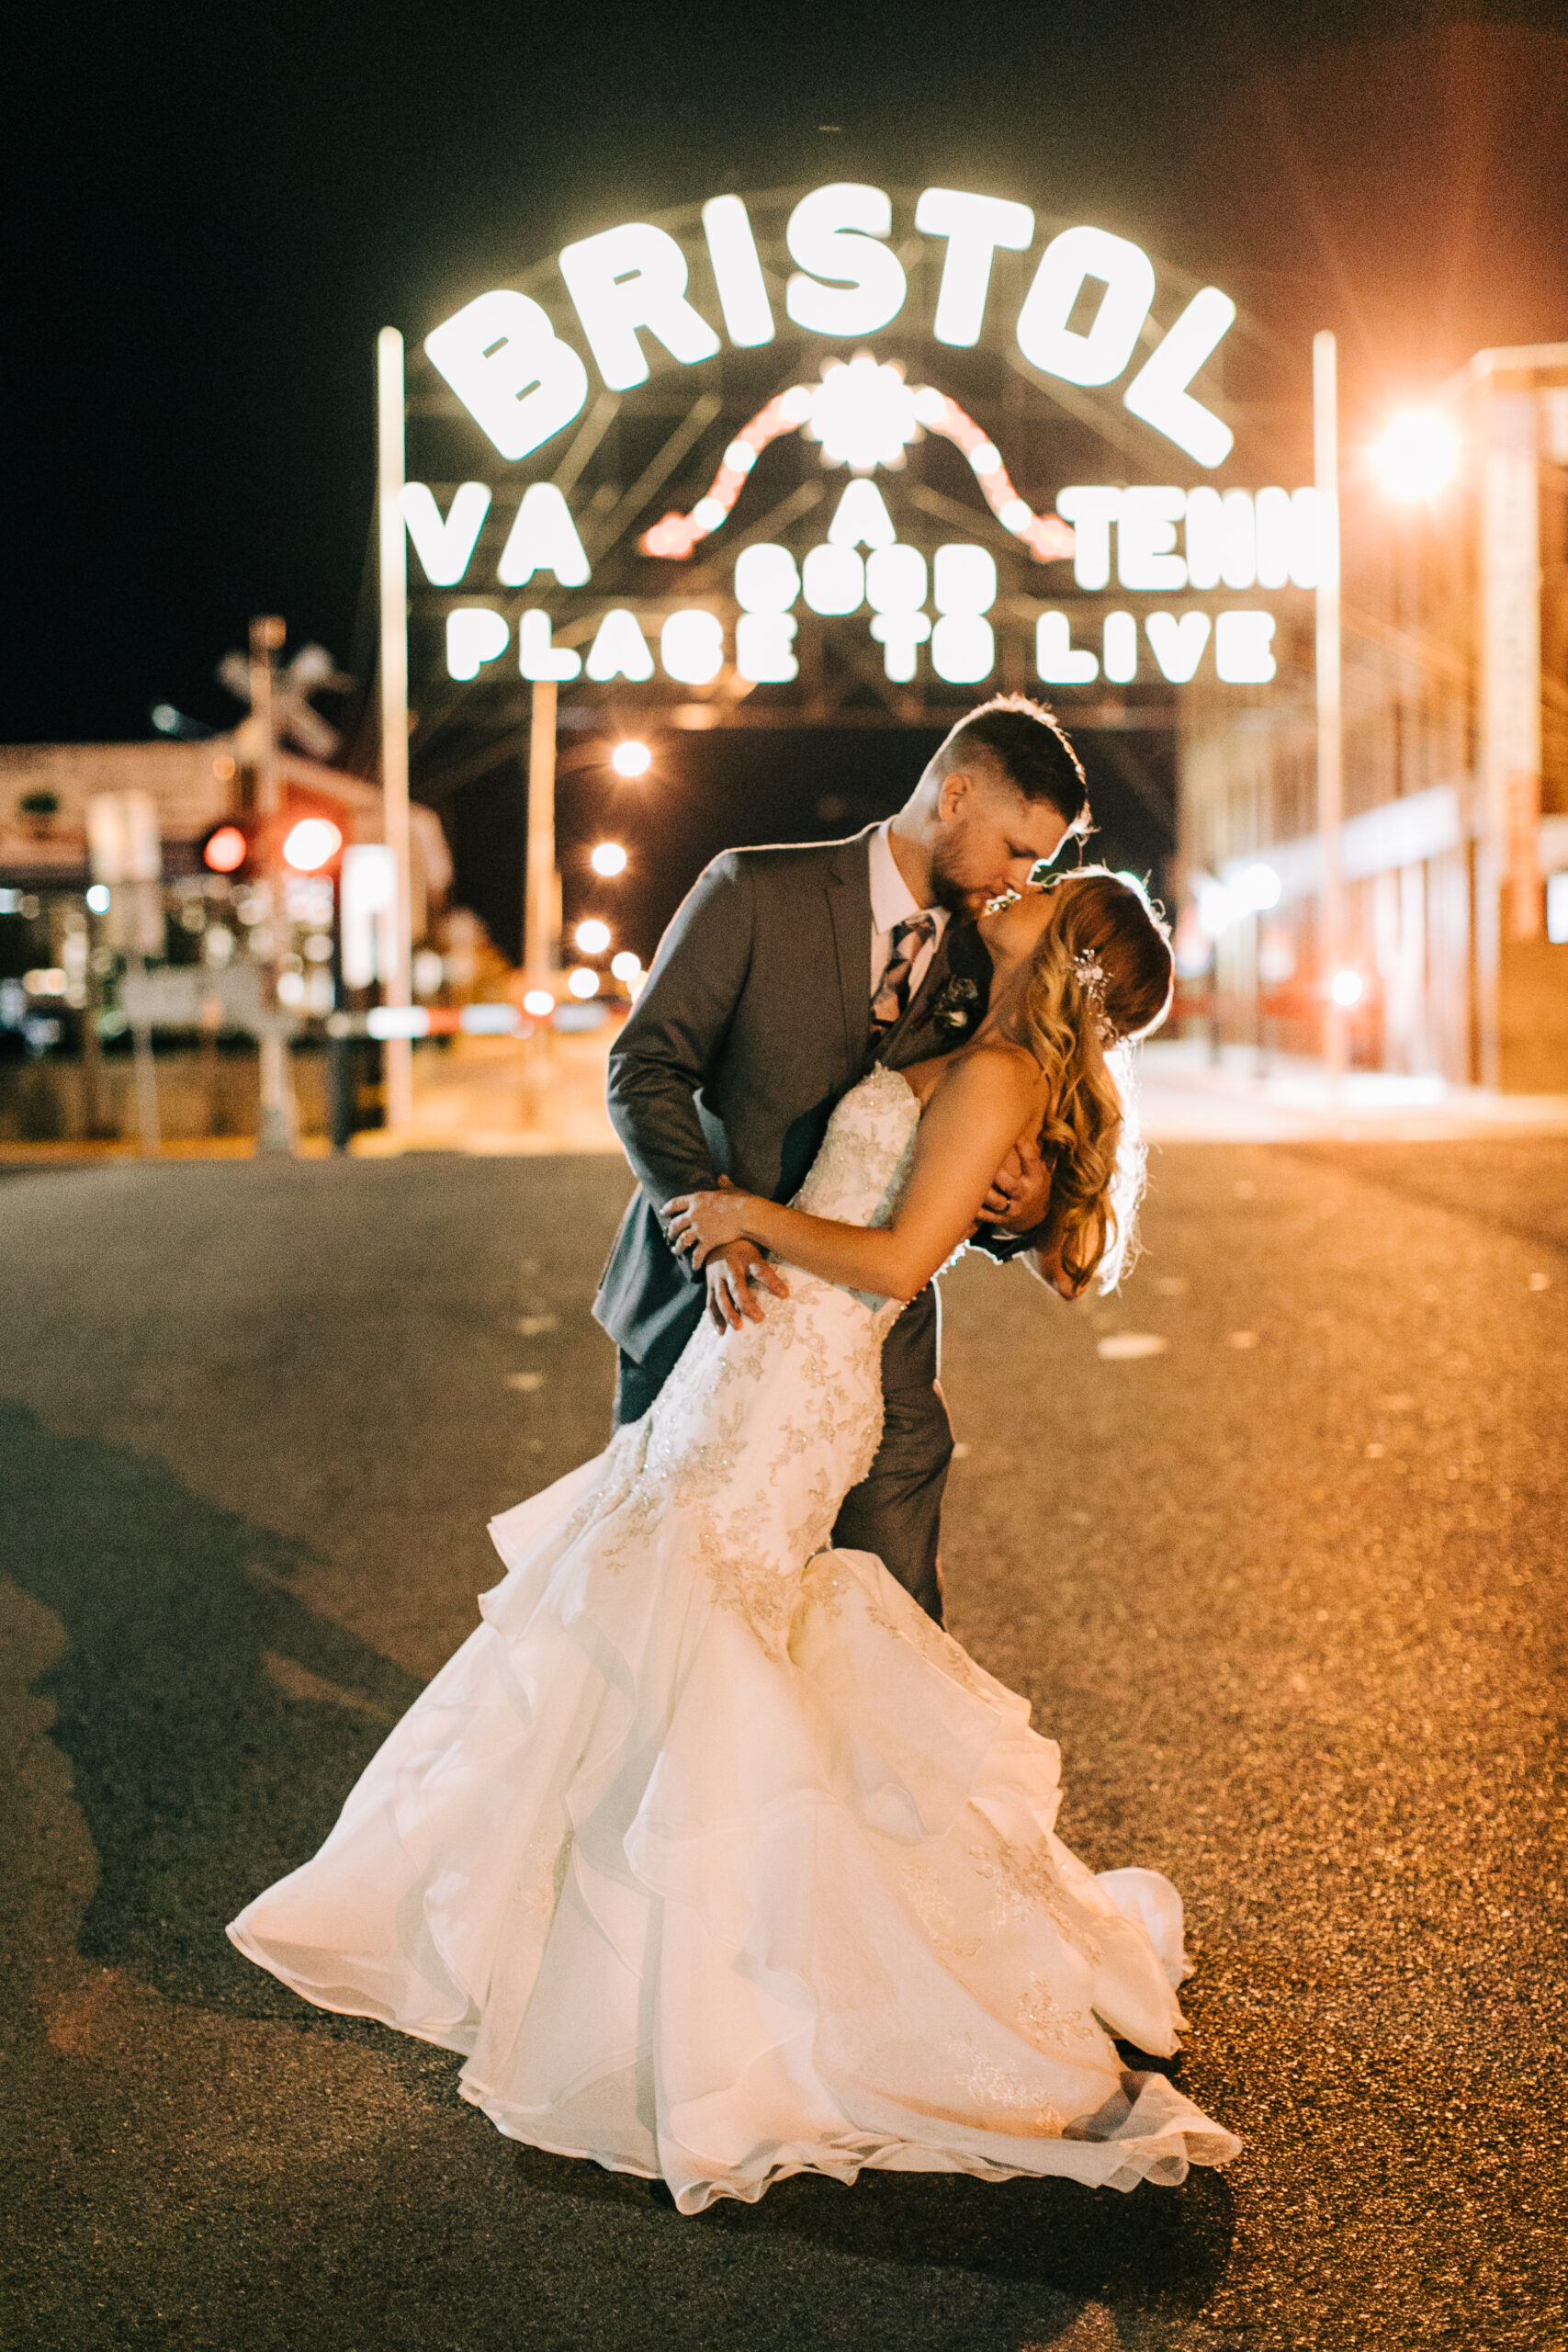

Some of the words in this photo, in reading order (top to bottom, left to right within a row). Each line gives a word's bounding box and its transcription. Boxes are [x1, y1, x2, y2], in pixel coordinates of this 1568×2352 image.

[424, 183, 1236, 469] BRISTOL
[400, 481, 591, 587] VA
[828, 478, 897, 548] A
[1056, 486, 1338, 591] TENN
[735, 543, 997, 616] GOOD
[446, 608, 797, 684] PLACE
[870, 613, 995, 684] TO
[1036, 611, 1277, 684] LIVE
